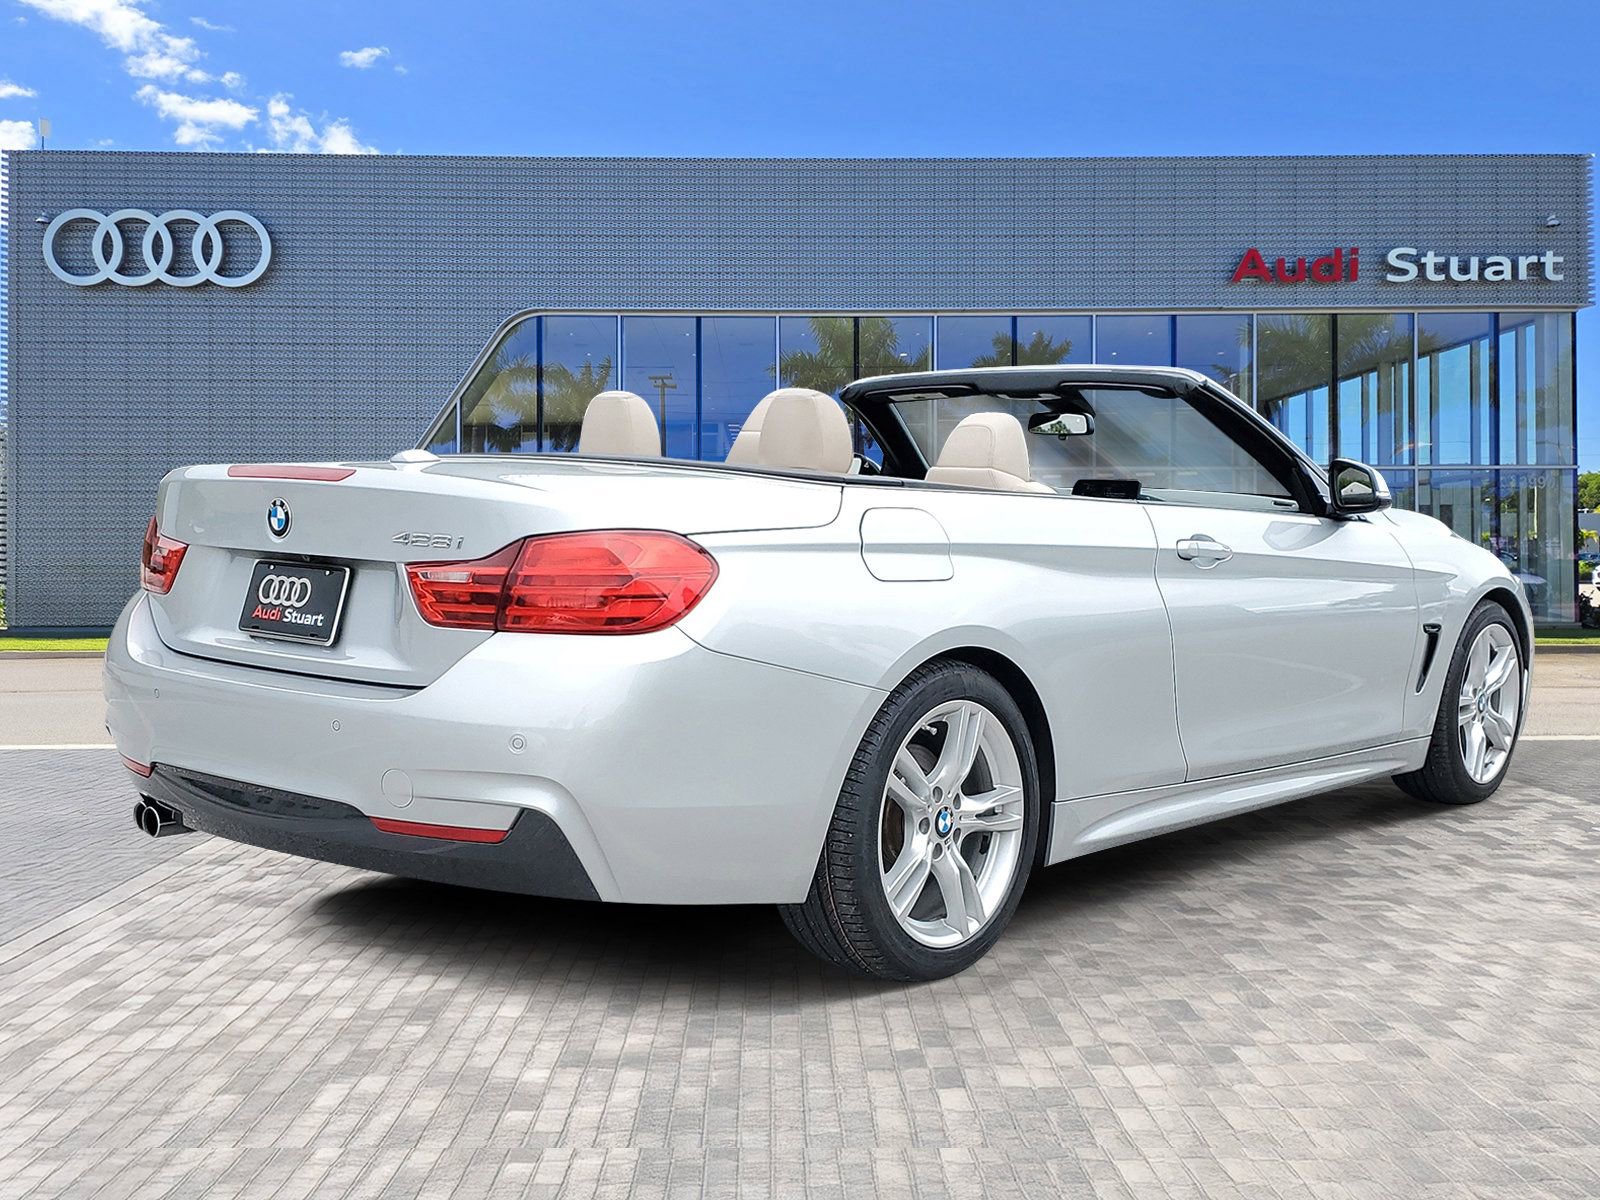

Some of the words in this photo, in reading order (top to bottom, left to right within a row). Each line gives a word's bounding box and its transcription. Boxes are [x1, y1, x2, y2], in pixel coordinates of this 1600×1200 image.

[1232, 247, 1359, 283] Audi
[1386, 247, 1564, 282] Stuart
[252, 605, 282, 621] Audi
[282, 608, 324, 626] Stuart
